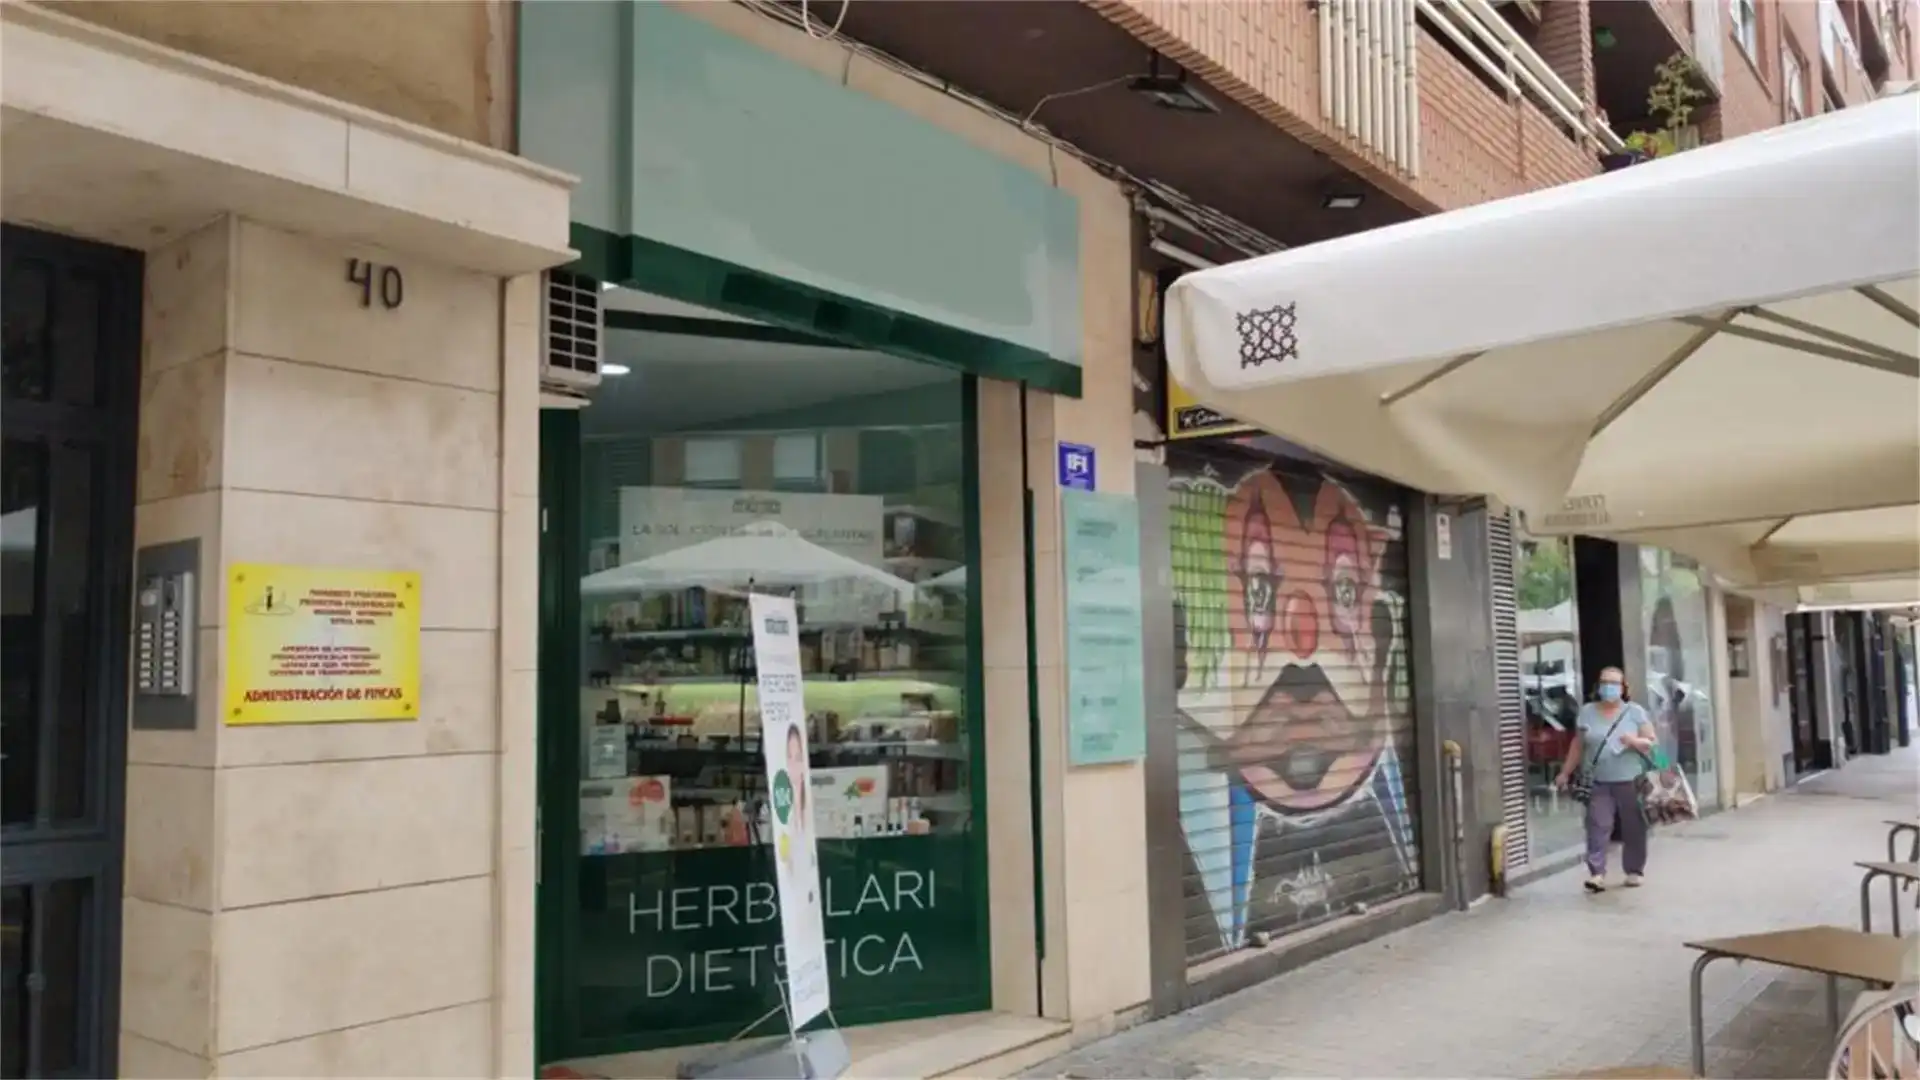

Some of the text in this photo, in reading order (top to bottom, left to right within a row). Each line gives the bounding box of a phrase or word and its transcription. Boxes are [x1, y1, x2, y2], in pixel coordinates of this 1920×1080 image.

[346, 257, 403, 309] 40
[244, 685, 402, 701] ADMINISTRACIÓN DE FINCAS
[629, 869, 936, 933] HERBLARI
